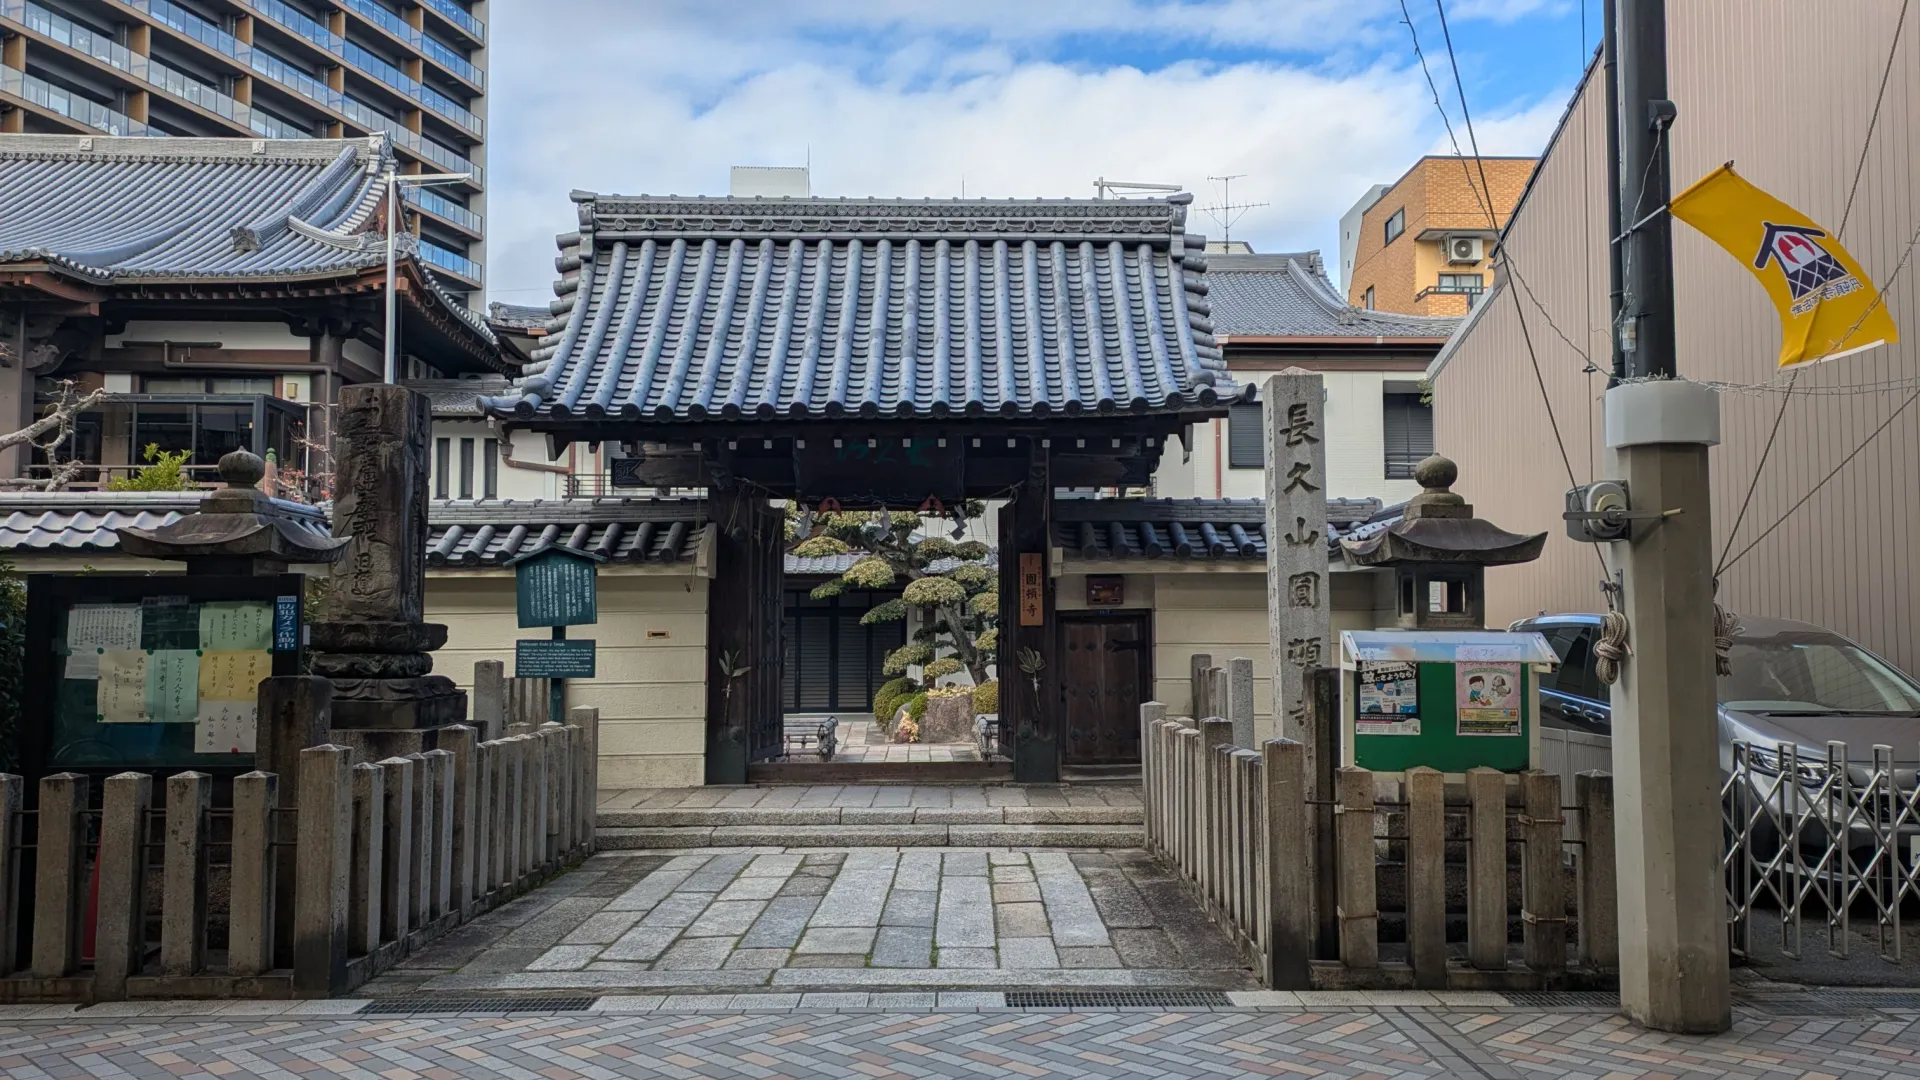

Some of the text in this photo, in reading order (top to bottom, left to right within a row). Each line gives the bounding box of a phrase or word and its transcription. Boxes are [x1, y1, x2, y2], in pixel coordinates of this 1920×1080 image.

[1025, 573, 1038, 617] 圓頓寺
[278, 603, 296, 649] 防犯カメラ作動中
[226, 655, 236, 697] あなたの心を
[206, 715, 216, 746] 私の都合
[221, 706, 230, 731] みんな
